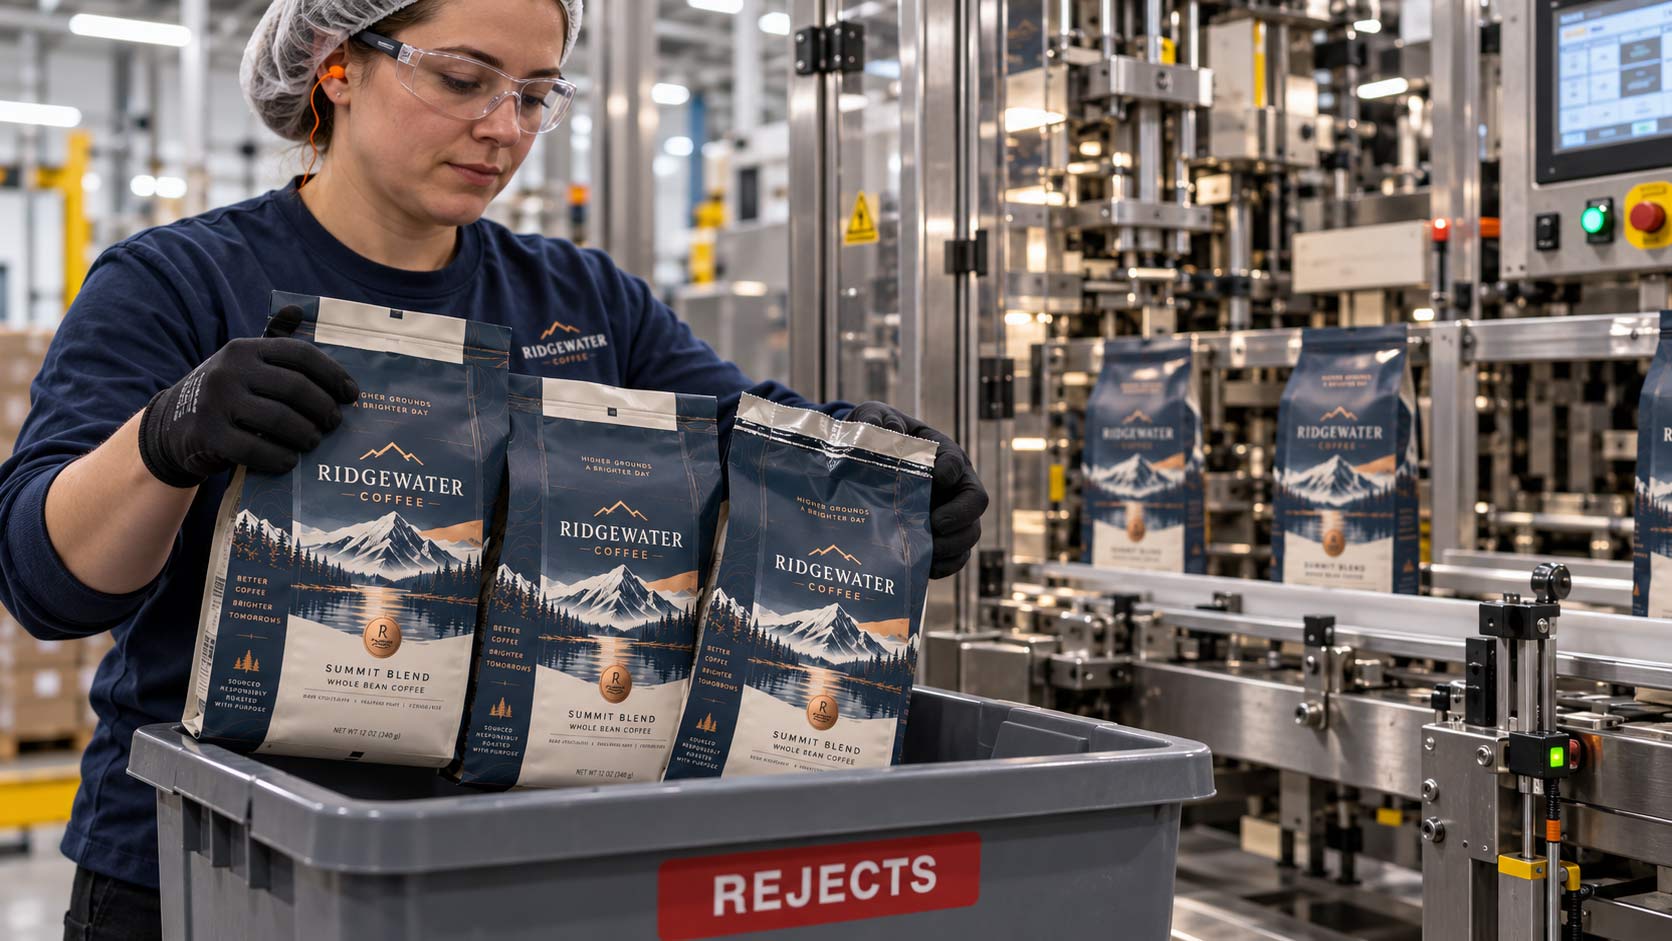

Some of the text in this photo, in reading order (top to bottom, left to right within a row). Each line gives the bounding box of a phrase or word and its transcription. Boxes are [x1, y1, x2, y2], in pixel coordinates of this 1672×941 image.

[521, 334, 608, 359] RIDGEWATER
[361, 391, 385, 401] GHER
[362, 402, 407, 414] BRIGHTER
[1102, 427, 1174, 440] RIDGEWATER
[1297, 425, 1383, 439] RIDGEWATER
[317, 464, 464, 496] RIDGEWATER
[360, 491, 423, 508] COFFEE
[560, 520, 683, 548] RIDGEWATER
[594, 546, 648, 560] COFFEE
[775, 554, 895, 595] RIDGEWATER
[808, 582, 861, 601] COFFEE
[378, 624, 388, 639] R
[325, 664, 430, 682] SUMMIT BLEND
[612, 671, 621, 685] R
[327, 678, 425, 694] WHOLE BEAN COFFEE
[819, 700, 827, 714] R
[568, 710, 656, 723] SUMMIT BLEND
[332, 727, 345, 735] NET
[348, 728, 359, 736] WT
[569, 723, 652, 735] WHOLE BEAN COFFEE
[773, 730, 861, 755] SUMMIT BLEND
[773, 744, 800, 754] WHOLE
[803, 749, 824, 759] BEAN
[827, 754, 856, 765] COFFEE
[713, 855, 937, 916] REJECTS
